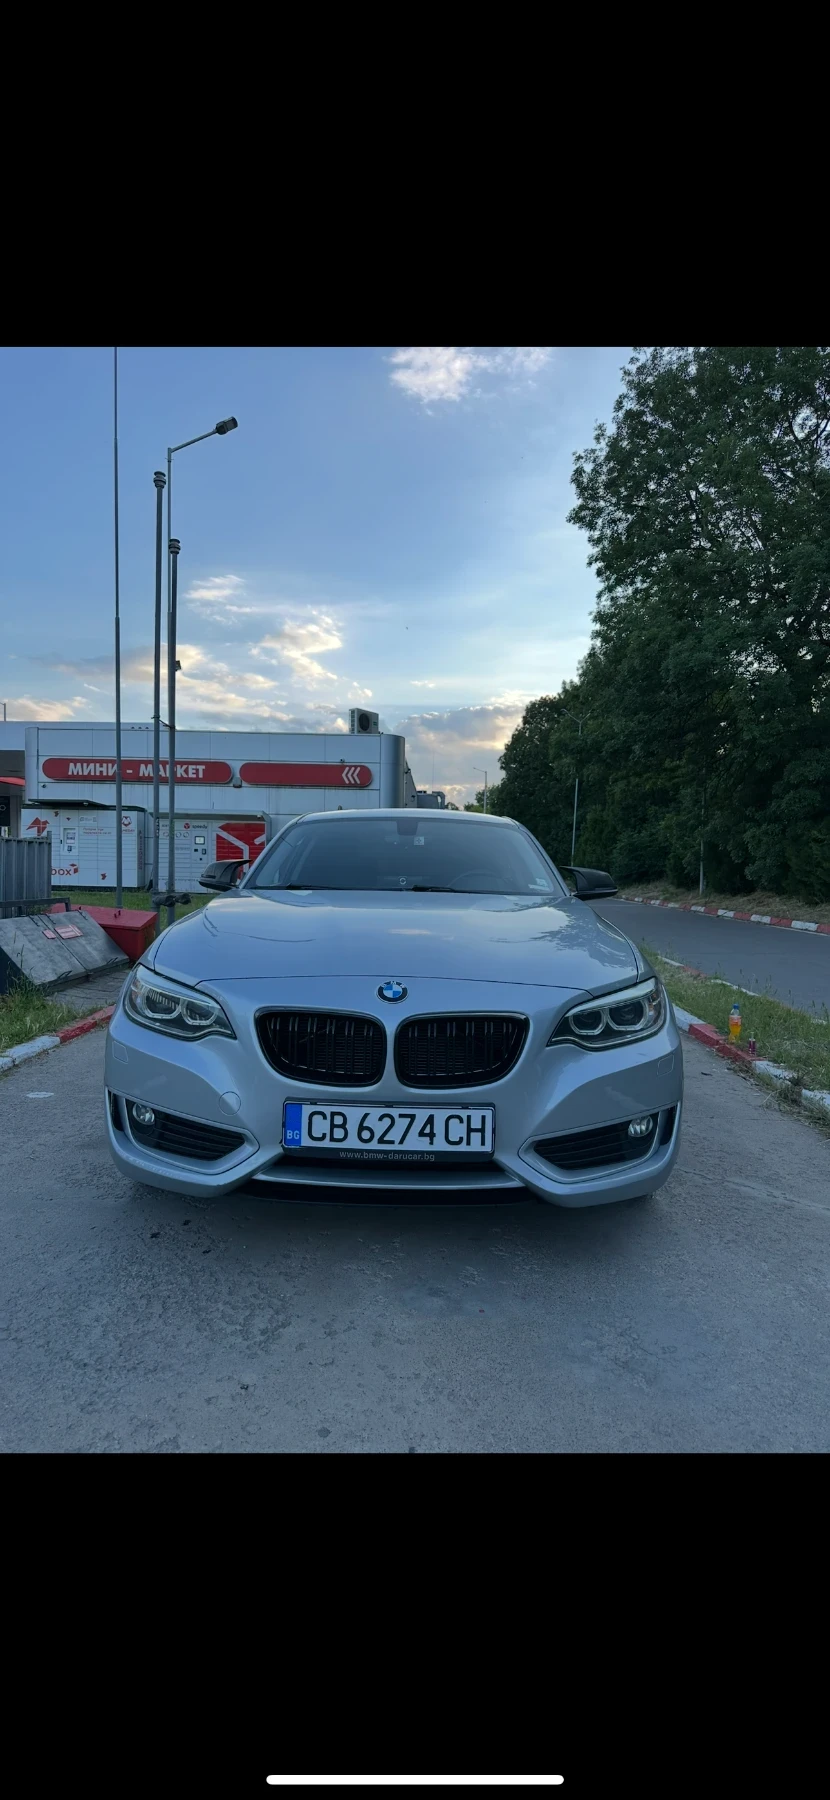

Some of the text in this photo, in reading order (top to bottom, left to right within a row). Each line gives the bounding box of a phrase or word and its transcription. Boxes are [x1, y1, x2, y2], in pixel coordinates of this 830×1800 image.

[68, 763, 117, 776] МИНИ
[286, 1130, 300, 1140] BG
[307, 1110, 487, 1147] CB 6274 CH
